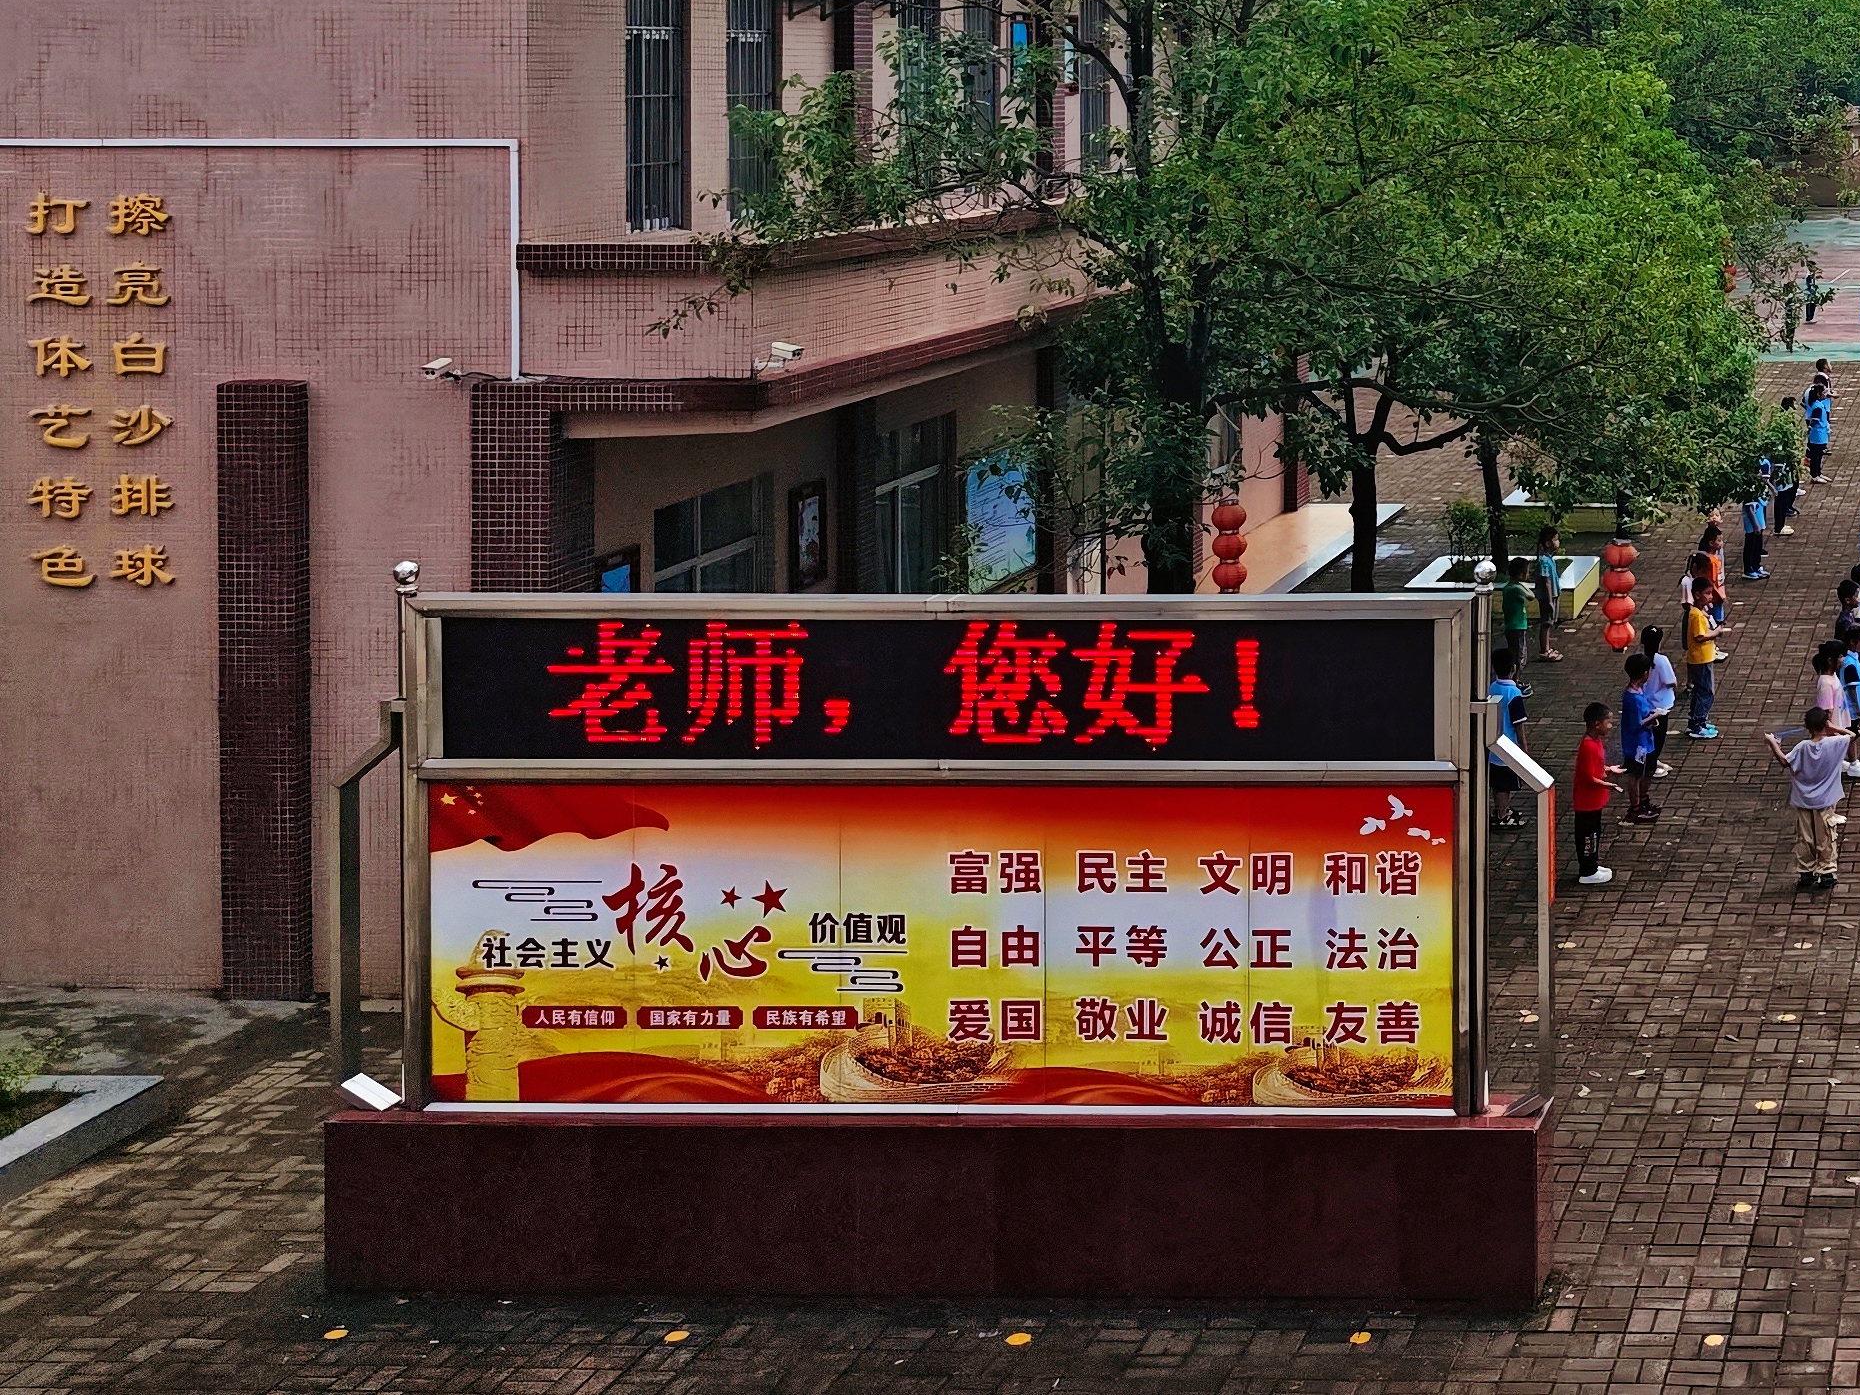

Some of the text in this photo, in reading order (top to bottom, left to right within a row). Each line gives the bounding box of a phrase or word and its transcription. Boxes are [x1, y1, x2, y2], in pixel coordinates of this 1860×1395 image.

[26, 192, 96, 588] 打造体艺特色
[106, 193, 174, 587] 擦亮白沙排球
[950, 850, 1422, 896] 富强 民主 文明 和谐
[482, 937, 615, 969] 社会主义
[809, 912, 907, 945] 价值观
[951, 924, 1420, 970] 自由 平等 公正 法治
[535, 1009, 615, 1026] 人民有信仰
[650, 1009, 731, 1026] 国家有力量
[766, 1009, 847, 1026] 民族有希望
[949, 997, 1420, 1044] 爱国 敬业 诚信 友善
